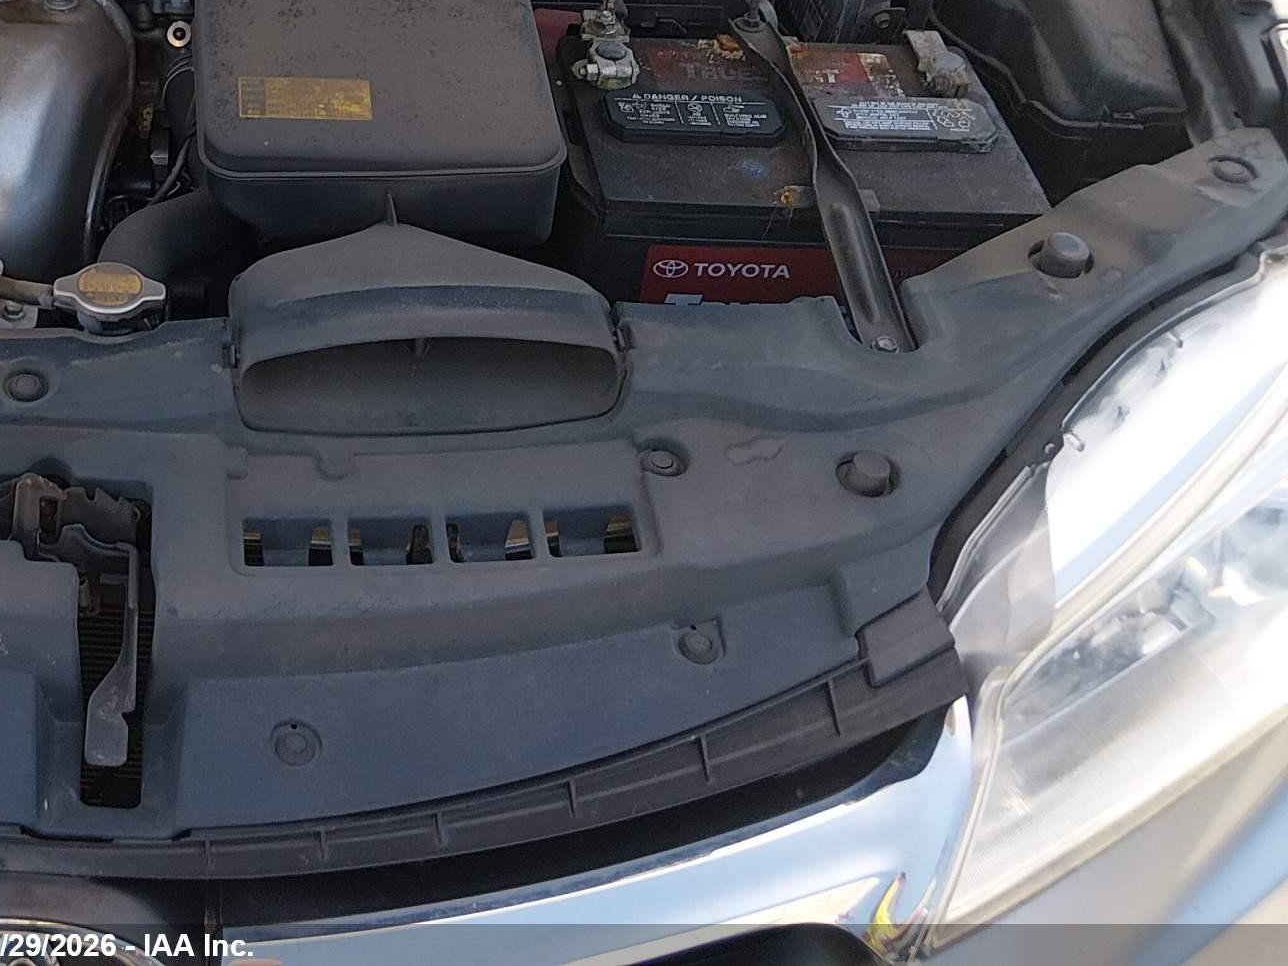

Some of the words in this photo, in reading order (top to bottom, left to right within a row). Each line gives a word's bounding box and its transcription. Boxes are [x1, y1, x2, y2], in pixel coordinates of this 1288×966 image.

[643, 93, 689, 102] DANGER
[700, 95, 743, 103] POISON
[693, 262, 791, 279] TOYOTA
